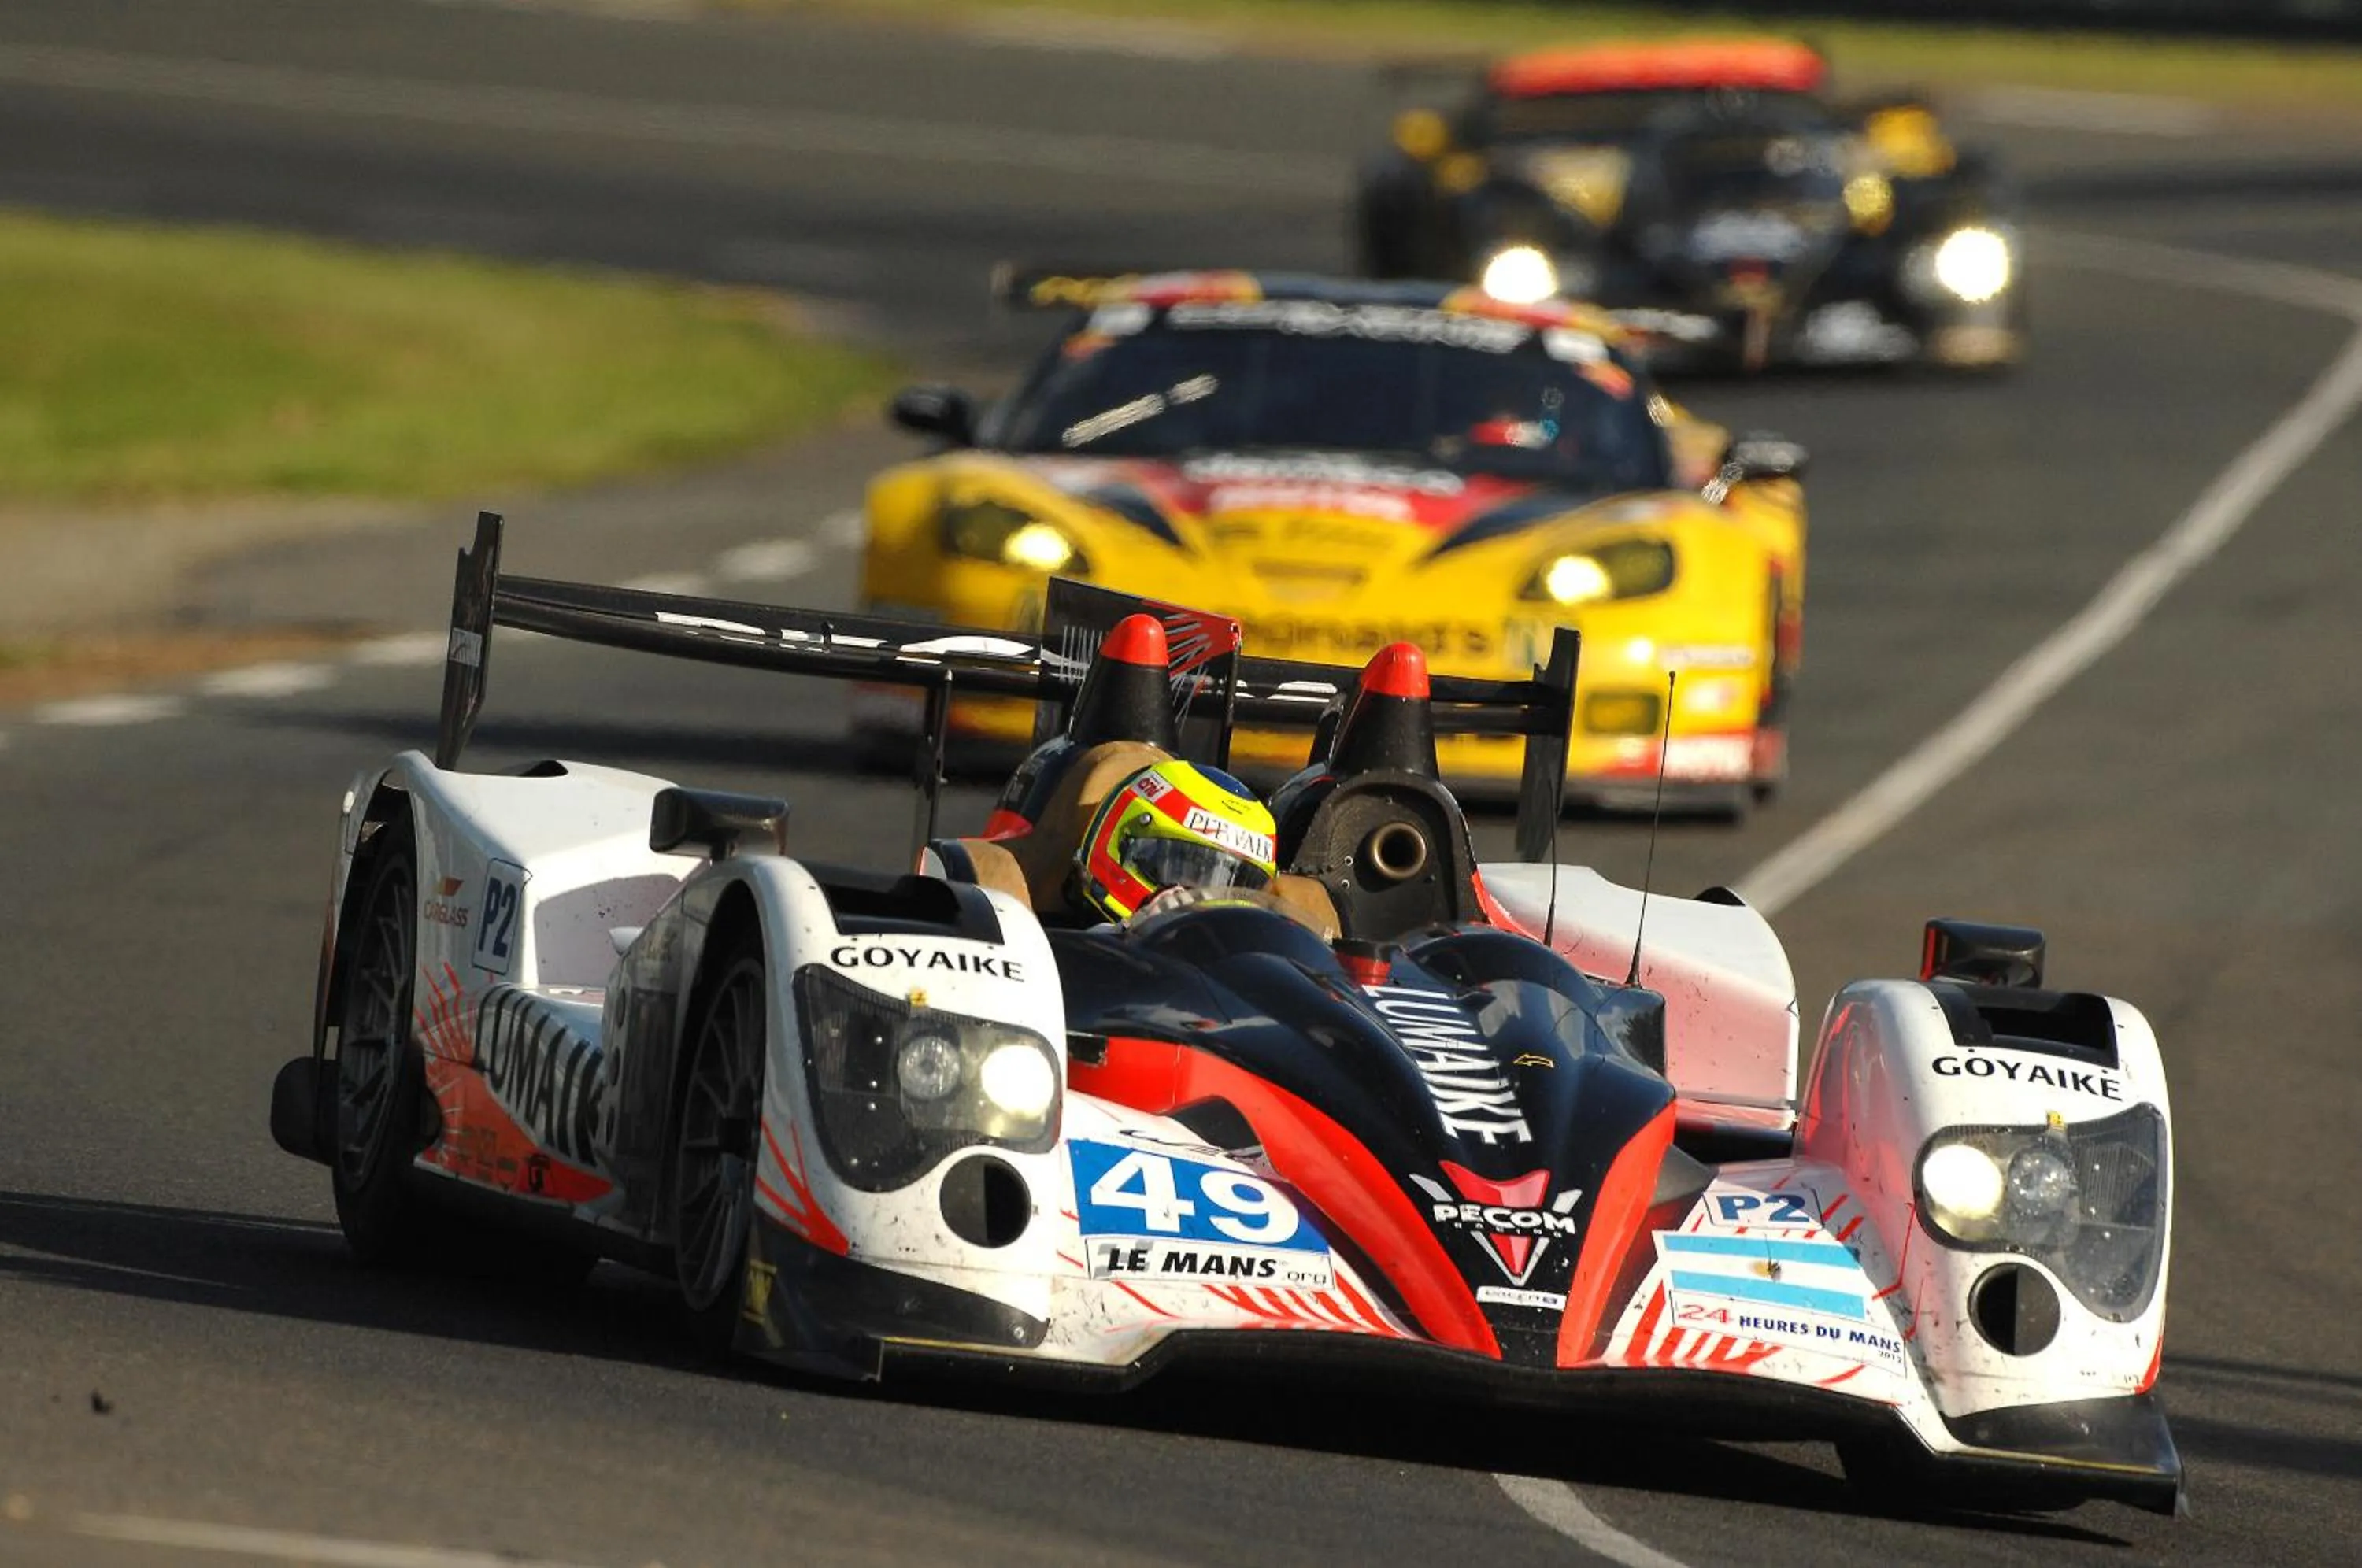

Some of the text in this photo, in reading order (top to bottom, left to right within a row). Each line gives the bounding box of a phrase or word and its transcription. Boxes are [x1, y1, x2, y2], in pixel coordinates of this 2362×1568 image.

[479, 877, 516, 958] P2
[831, 946, 1024, 983] GOYAIKE
[474, 983, 605, 1168] LUMAIK
[1931, 1056, 2123, 1102] GOYAIKE
[1091, 1152, 1299, 1244] 49
[1433, 1204, 1575, 1234] PECOM
[1717, 1194, 1810, 1222] P2
[1107, 1248, 1148, 1272] LE
[1161, 1251, 1278, 1278] MANS
[1679, 1304, 1901, 1354] 24 HEURES DU MANS
